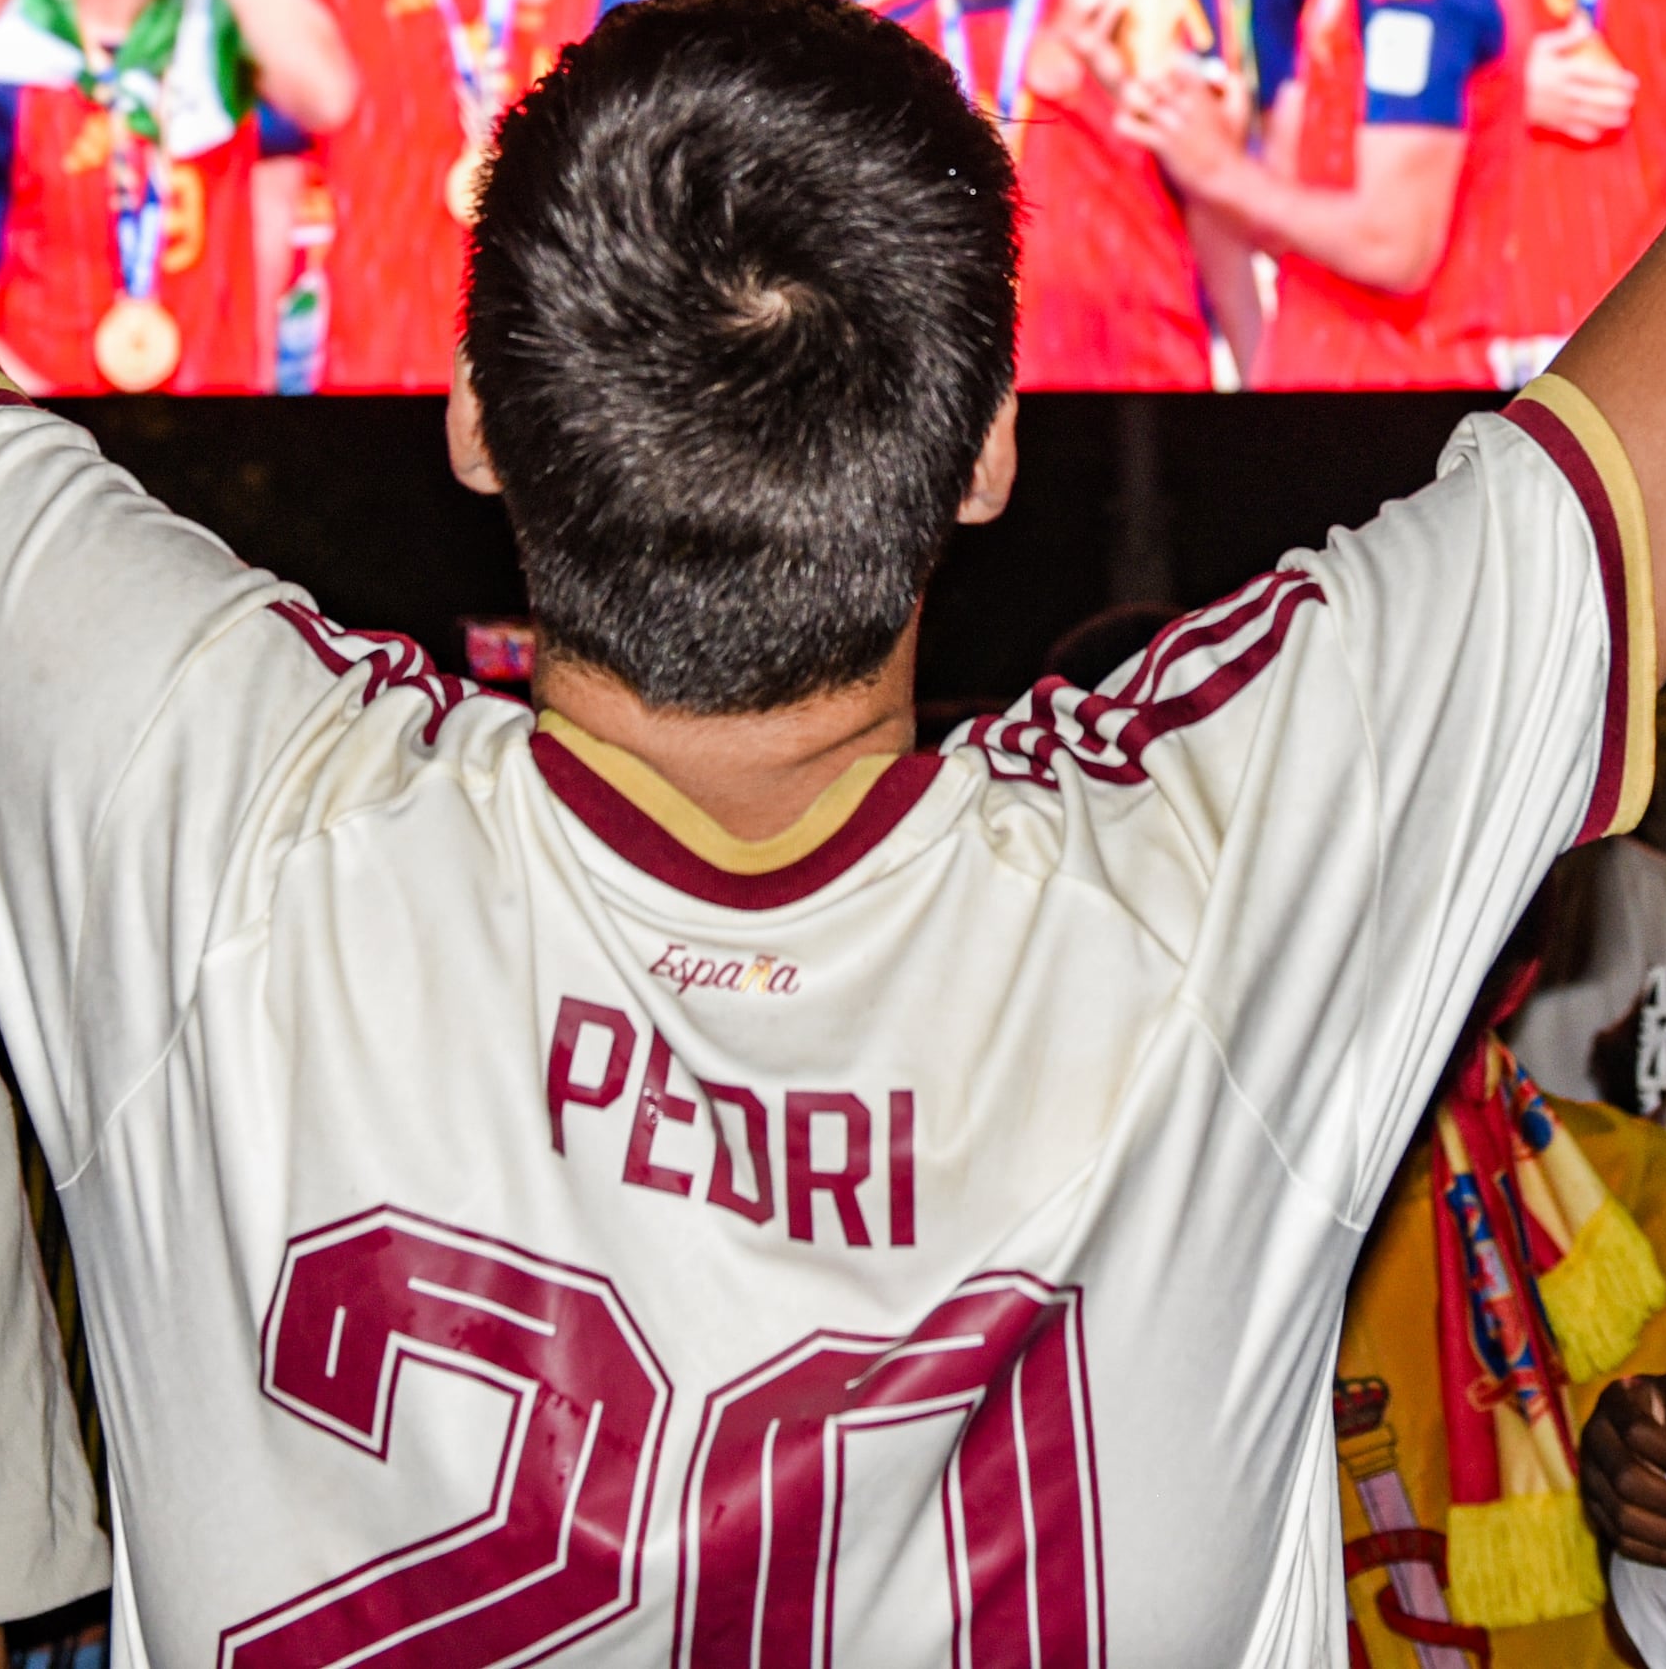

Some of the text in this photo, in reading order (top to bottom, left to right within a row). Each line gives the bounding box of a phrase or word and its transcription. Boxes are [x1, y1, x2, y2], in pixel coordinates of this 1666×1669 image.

[648, 943, 801, 996] España
[546, 995, 916, 1247] PEDRI
[217, 1203, 1107, 1669] 20
